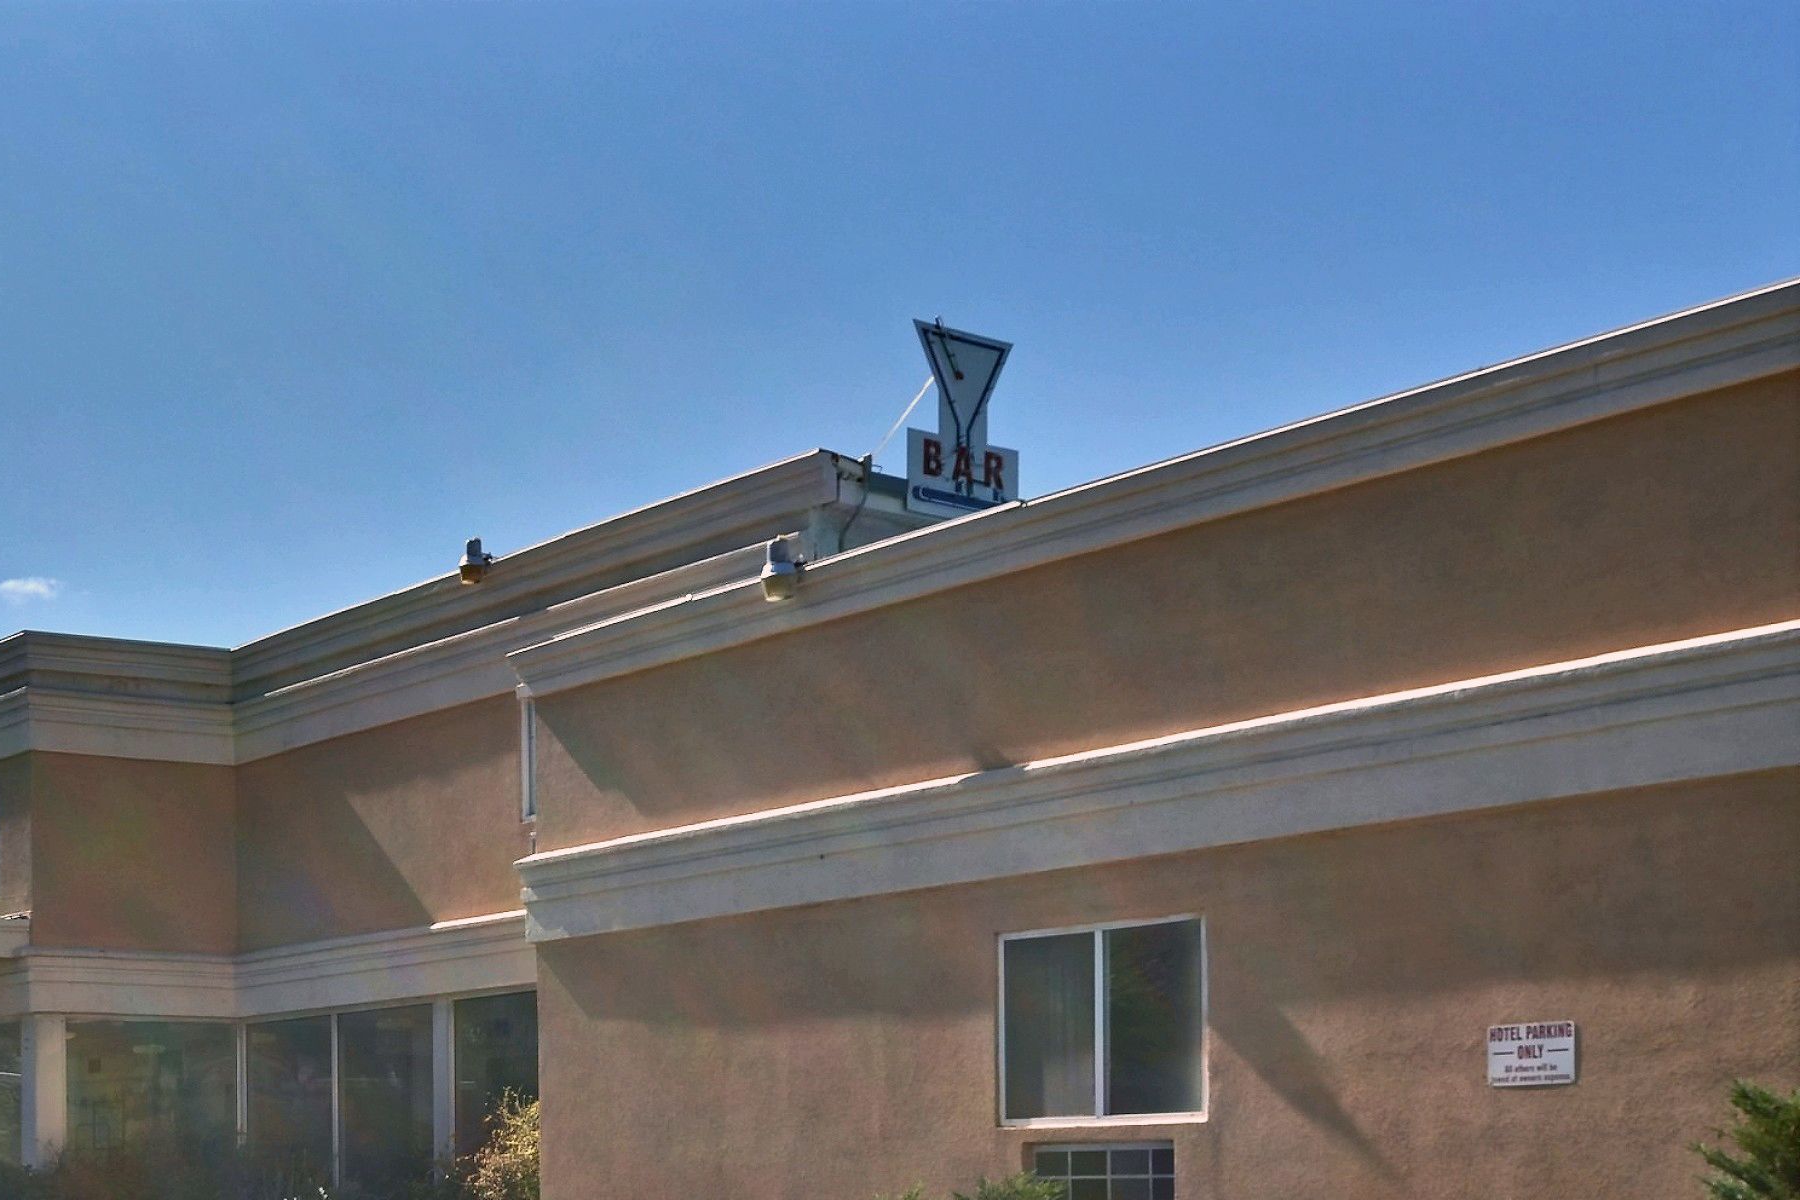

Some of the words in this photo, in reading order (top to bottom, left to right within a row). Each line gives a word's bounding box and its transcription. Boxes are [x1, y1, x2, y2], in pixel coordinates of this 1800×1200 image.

[923, 438, 1004, 490] BAR
[1489, 1026, 1521, 1042] HOTEL
[1526, 1022, 1572, 1039] PARKING
[1517, 1044, 1544, 1060] ONLY
